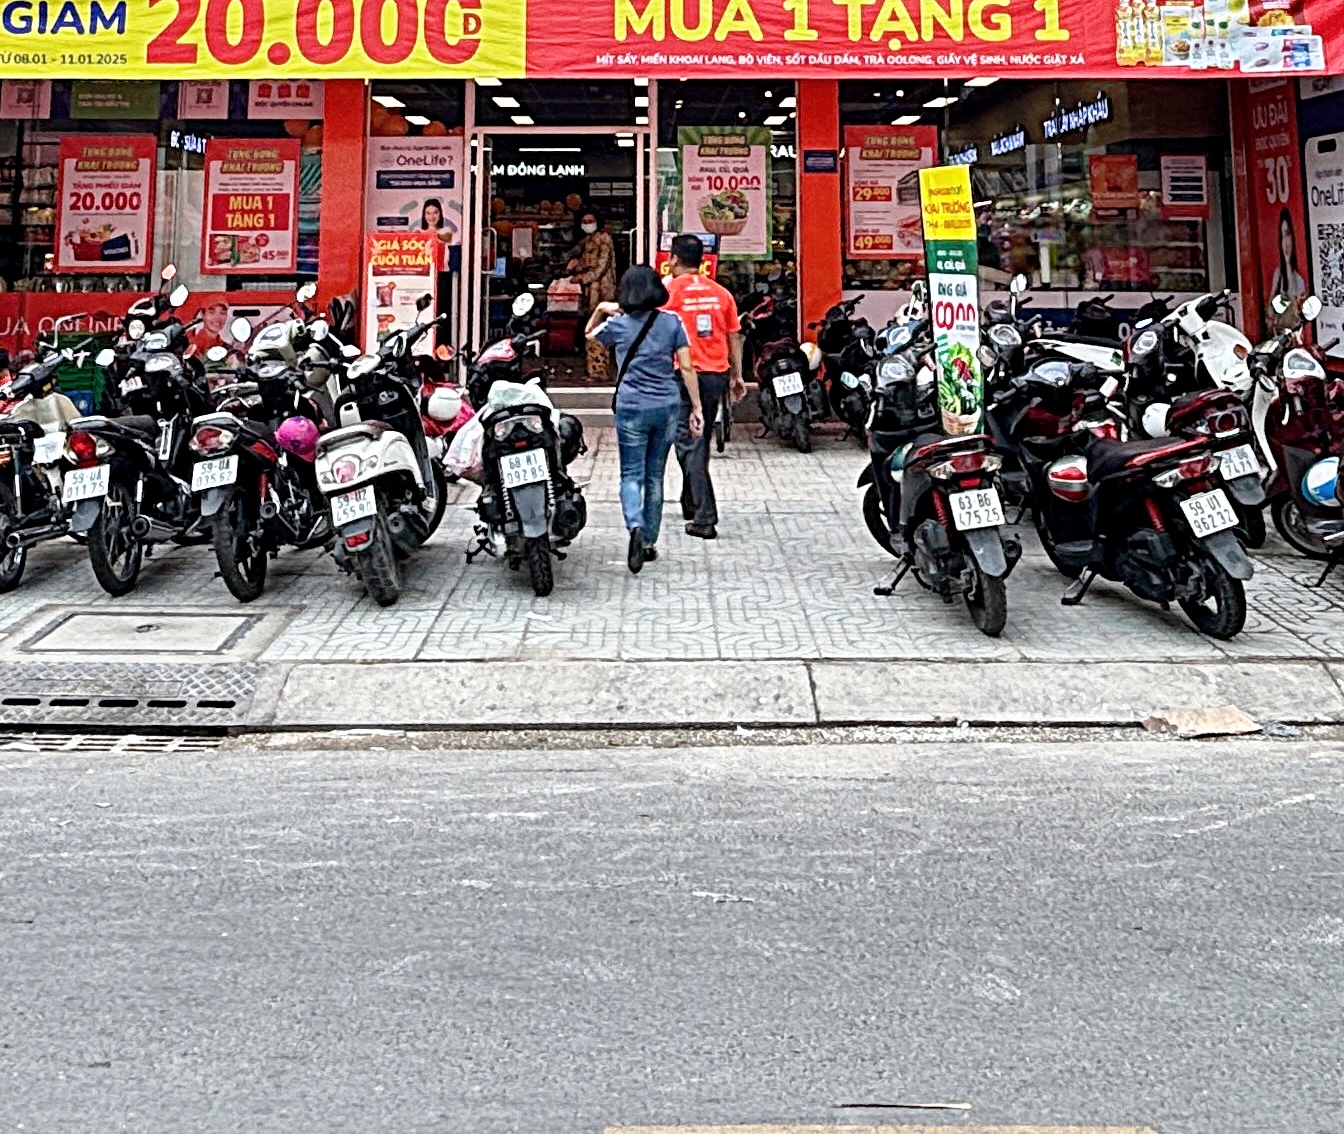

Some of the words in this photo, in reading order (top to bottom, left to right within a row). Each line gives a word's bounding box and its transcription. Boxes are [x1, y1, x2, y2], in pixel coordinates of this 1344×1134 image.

[14, 54, 47, 64] 08.01
[61, 54, 128, 65] 11.01.2025
[669, 54, 702, 65] KHOAI
[396, 154, 453, 167] OneLife?
[548, 164, 585, 178] LẠNH
[69, 192, 142, 211] 20.000
[229, 196, 263, 211] MUA
[266, 196, 273, 211] 1
[226, 211, 263, 228] TẶNG
[267, 213, 275, 227] 1
[378, 239, 400, 252] GIÁ
[371, 252, 399, 267] CUỐI
